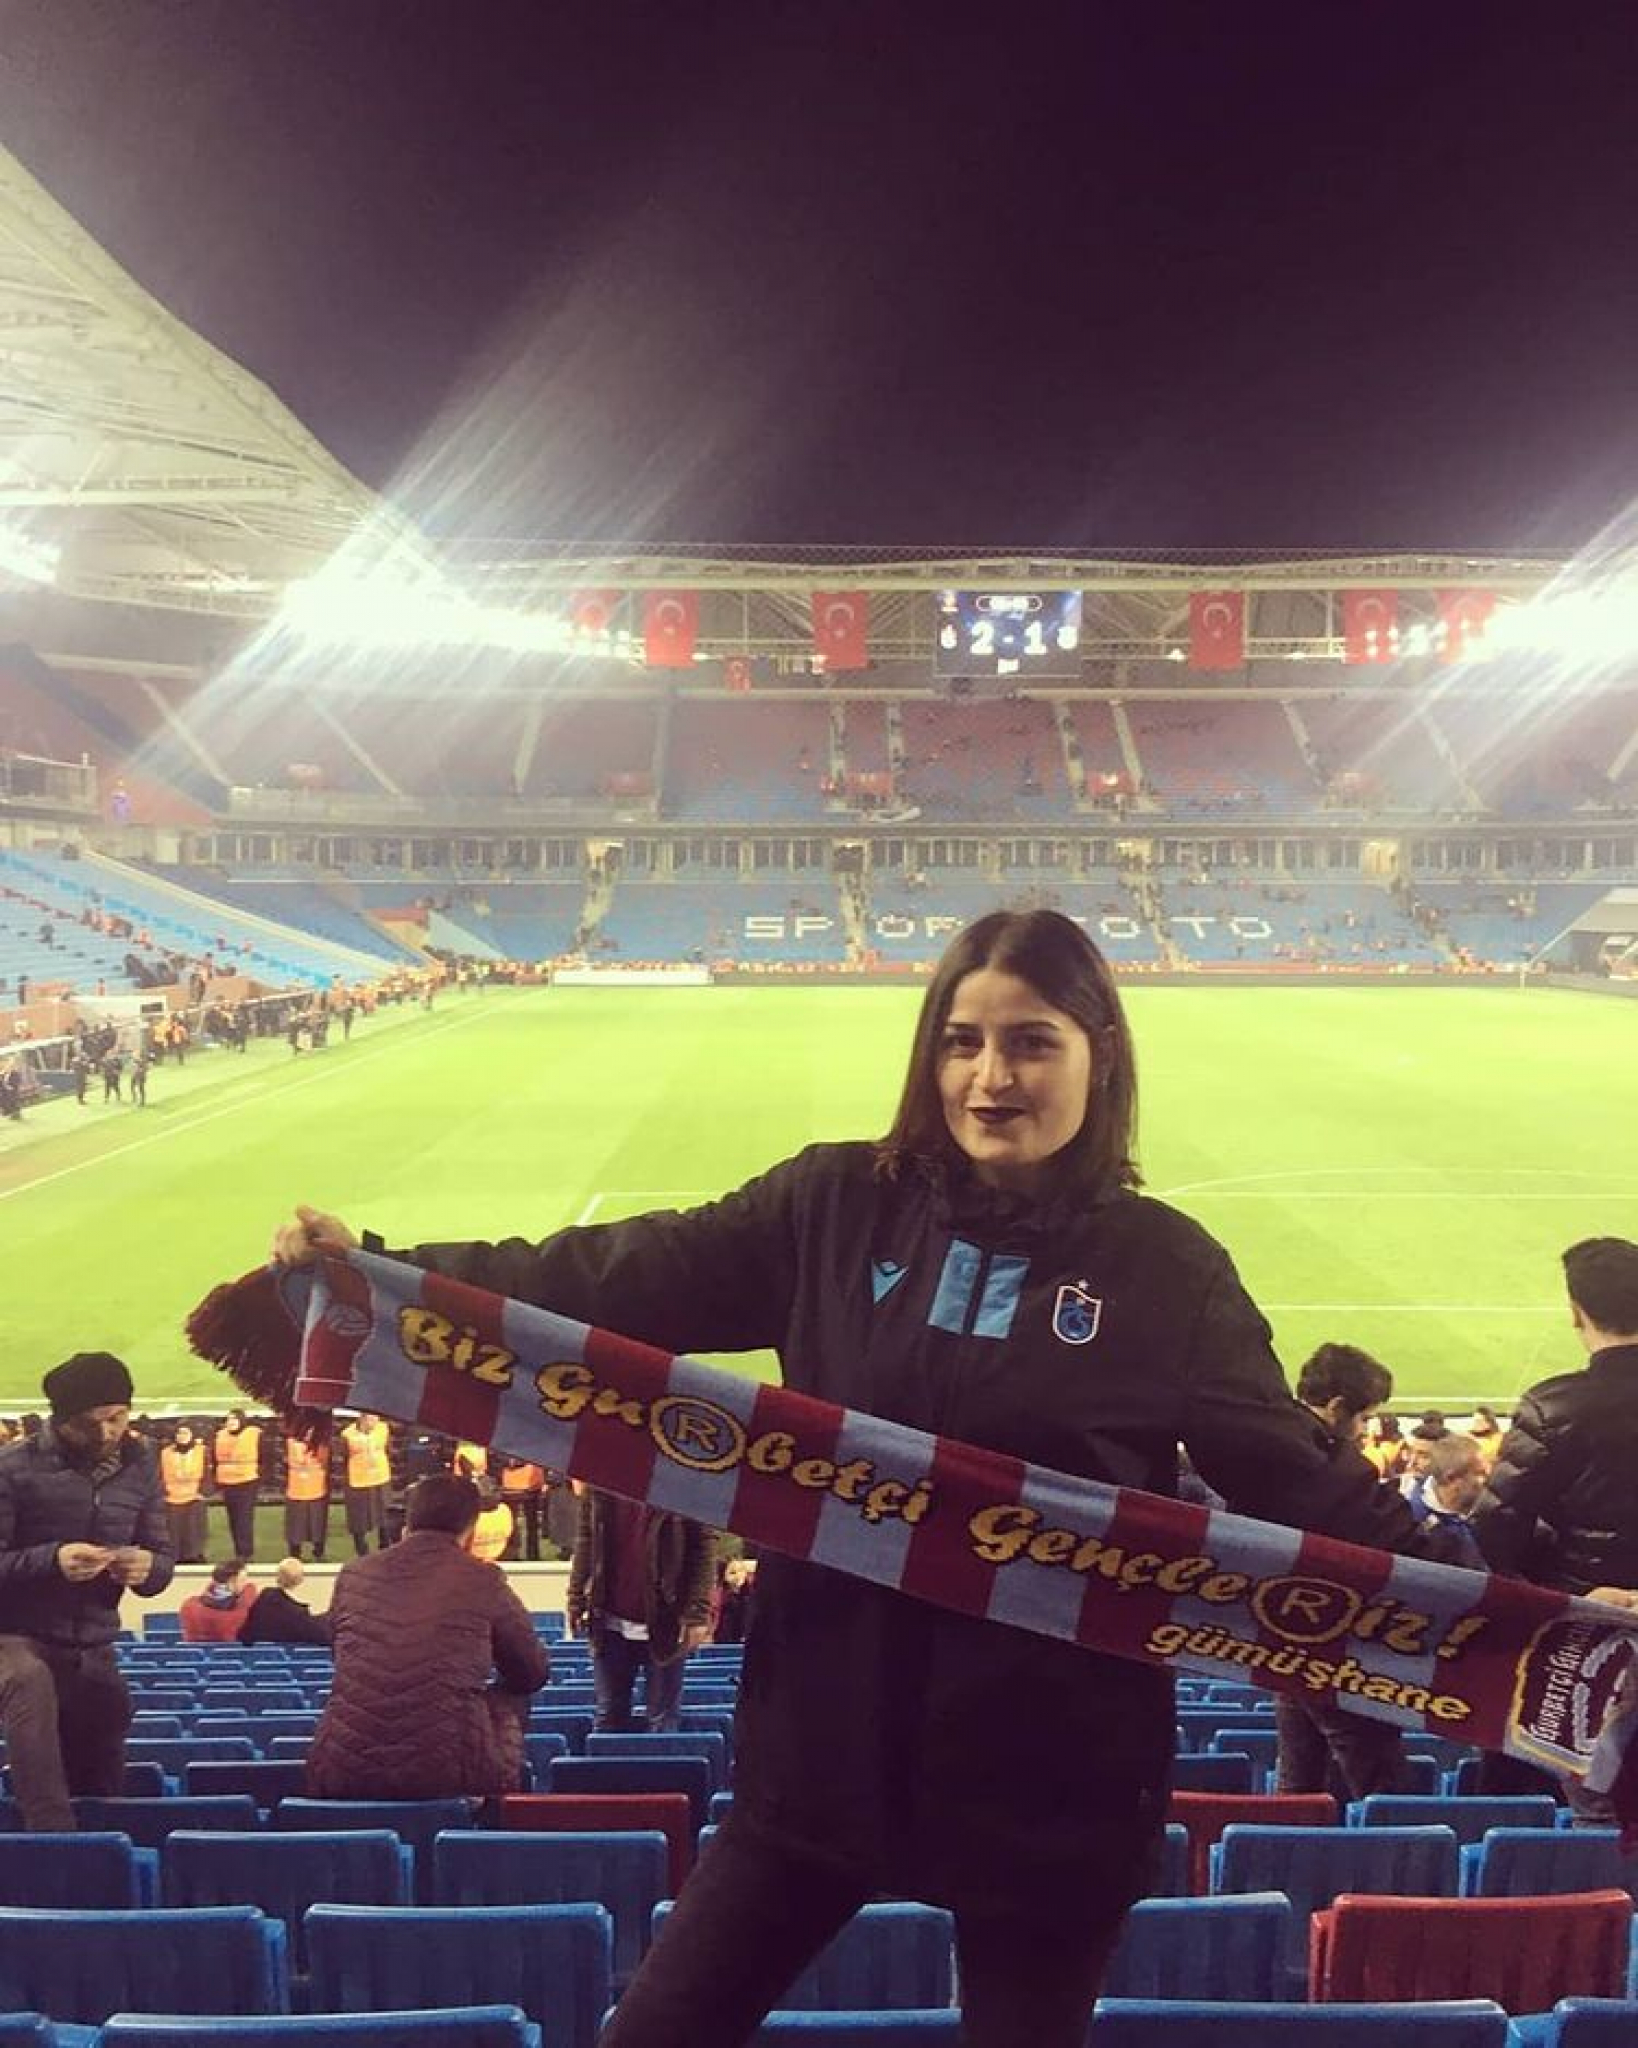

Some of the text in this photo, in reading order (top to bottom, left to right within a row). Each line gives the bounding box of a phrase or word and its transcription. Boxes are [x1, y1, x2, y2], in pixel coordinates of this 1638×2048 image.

[970, 620, 995, 655] 2
[1023, 621, 1048, 655] 1
[397, 1305, 516, 1389] Biz
[1145, 1620, 1473, 1723] gümüşhane
